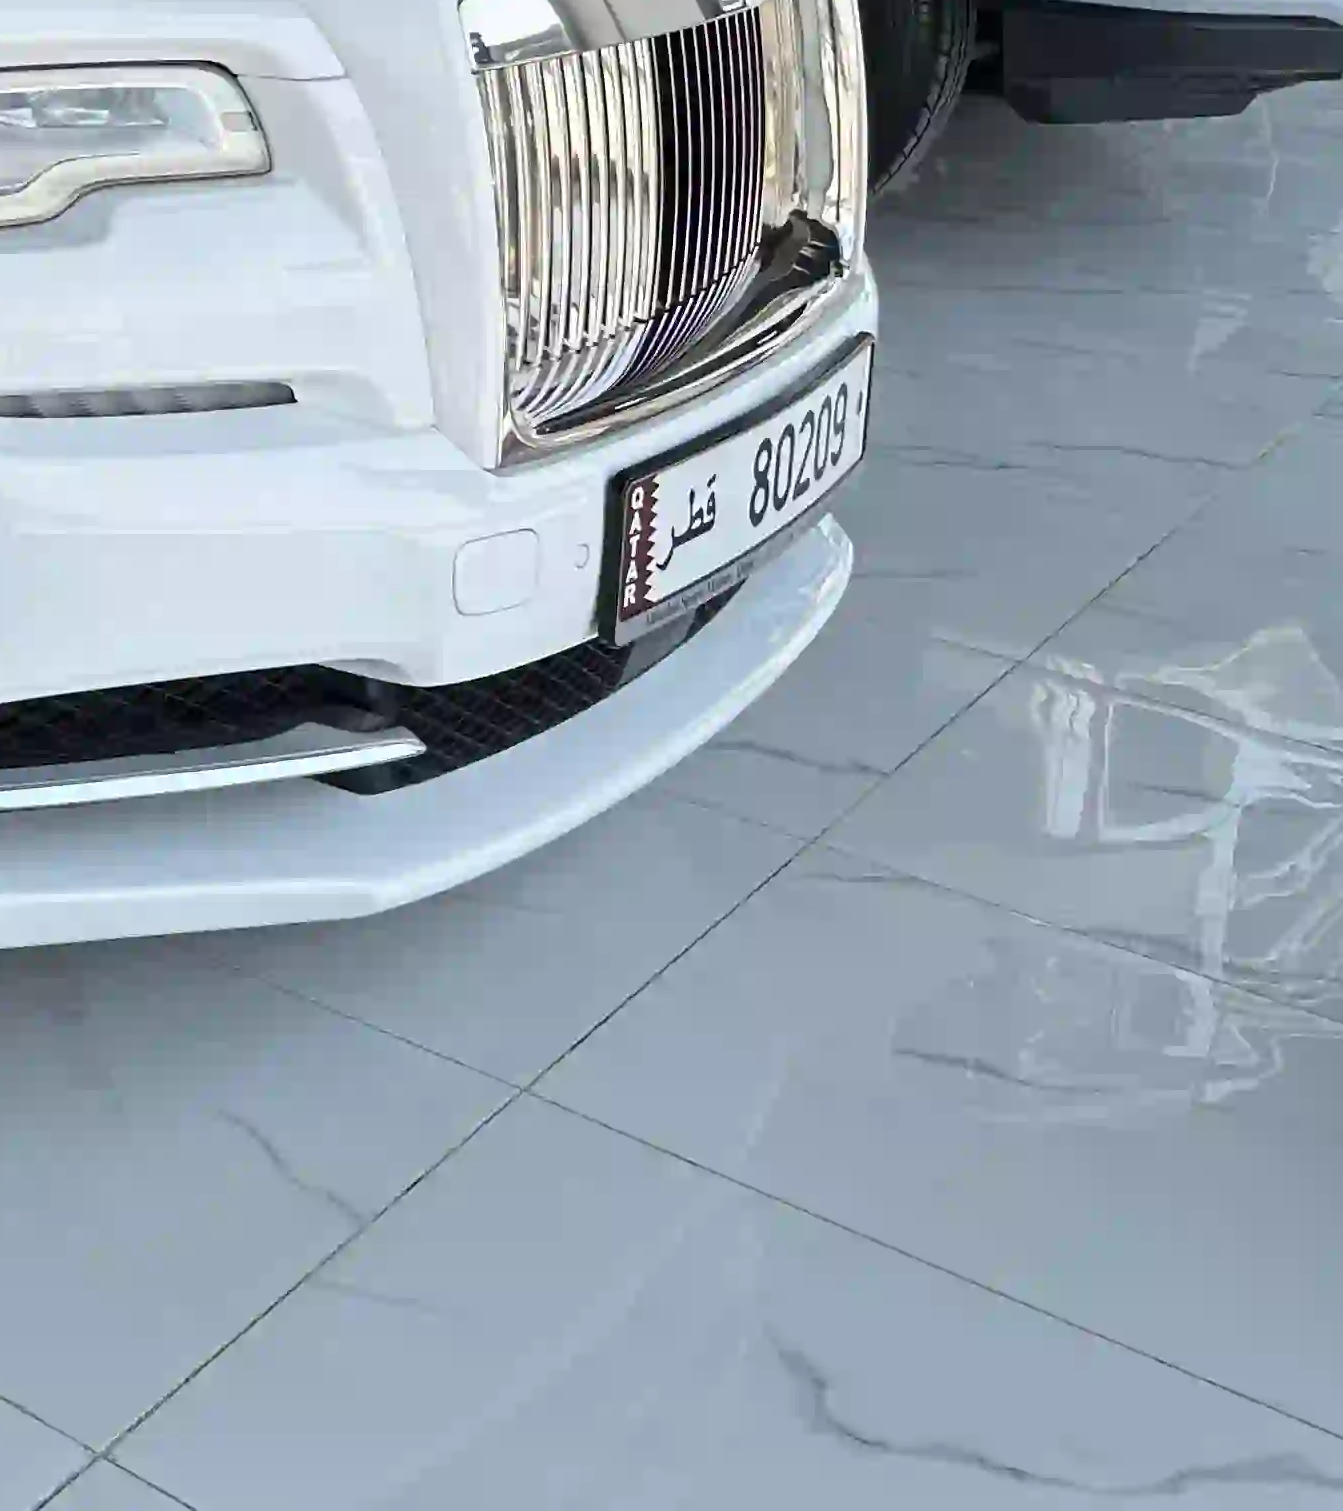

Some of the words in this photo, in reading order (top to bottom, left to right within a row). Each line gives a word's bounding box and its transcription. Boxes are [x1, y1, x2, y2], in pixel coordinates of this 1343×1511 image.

[749, 382, 847, 527] 80209
[622, 486, 645, 608] QATAR
[656, 473, 717, 571] قطر
